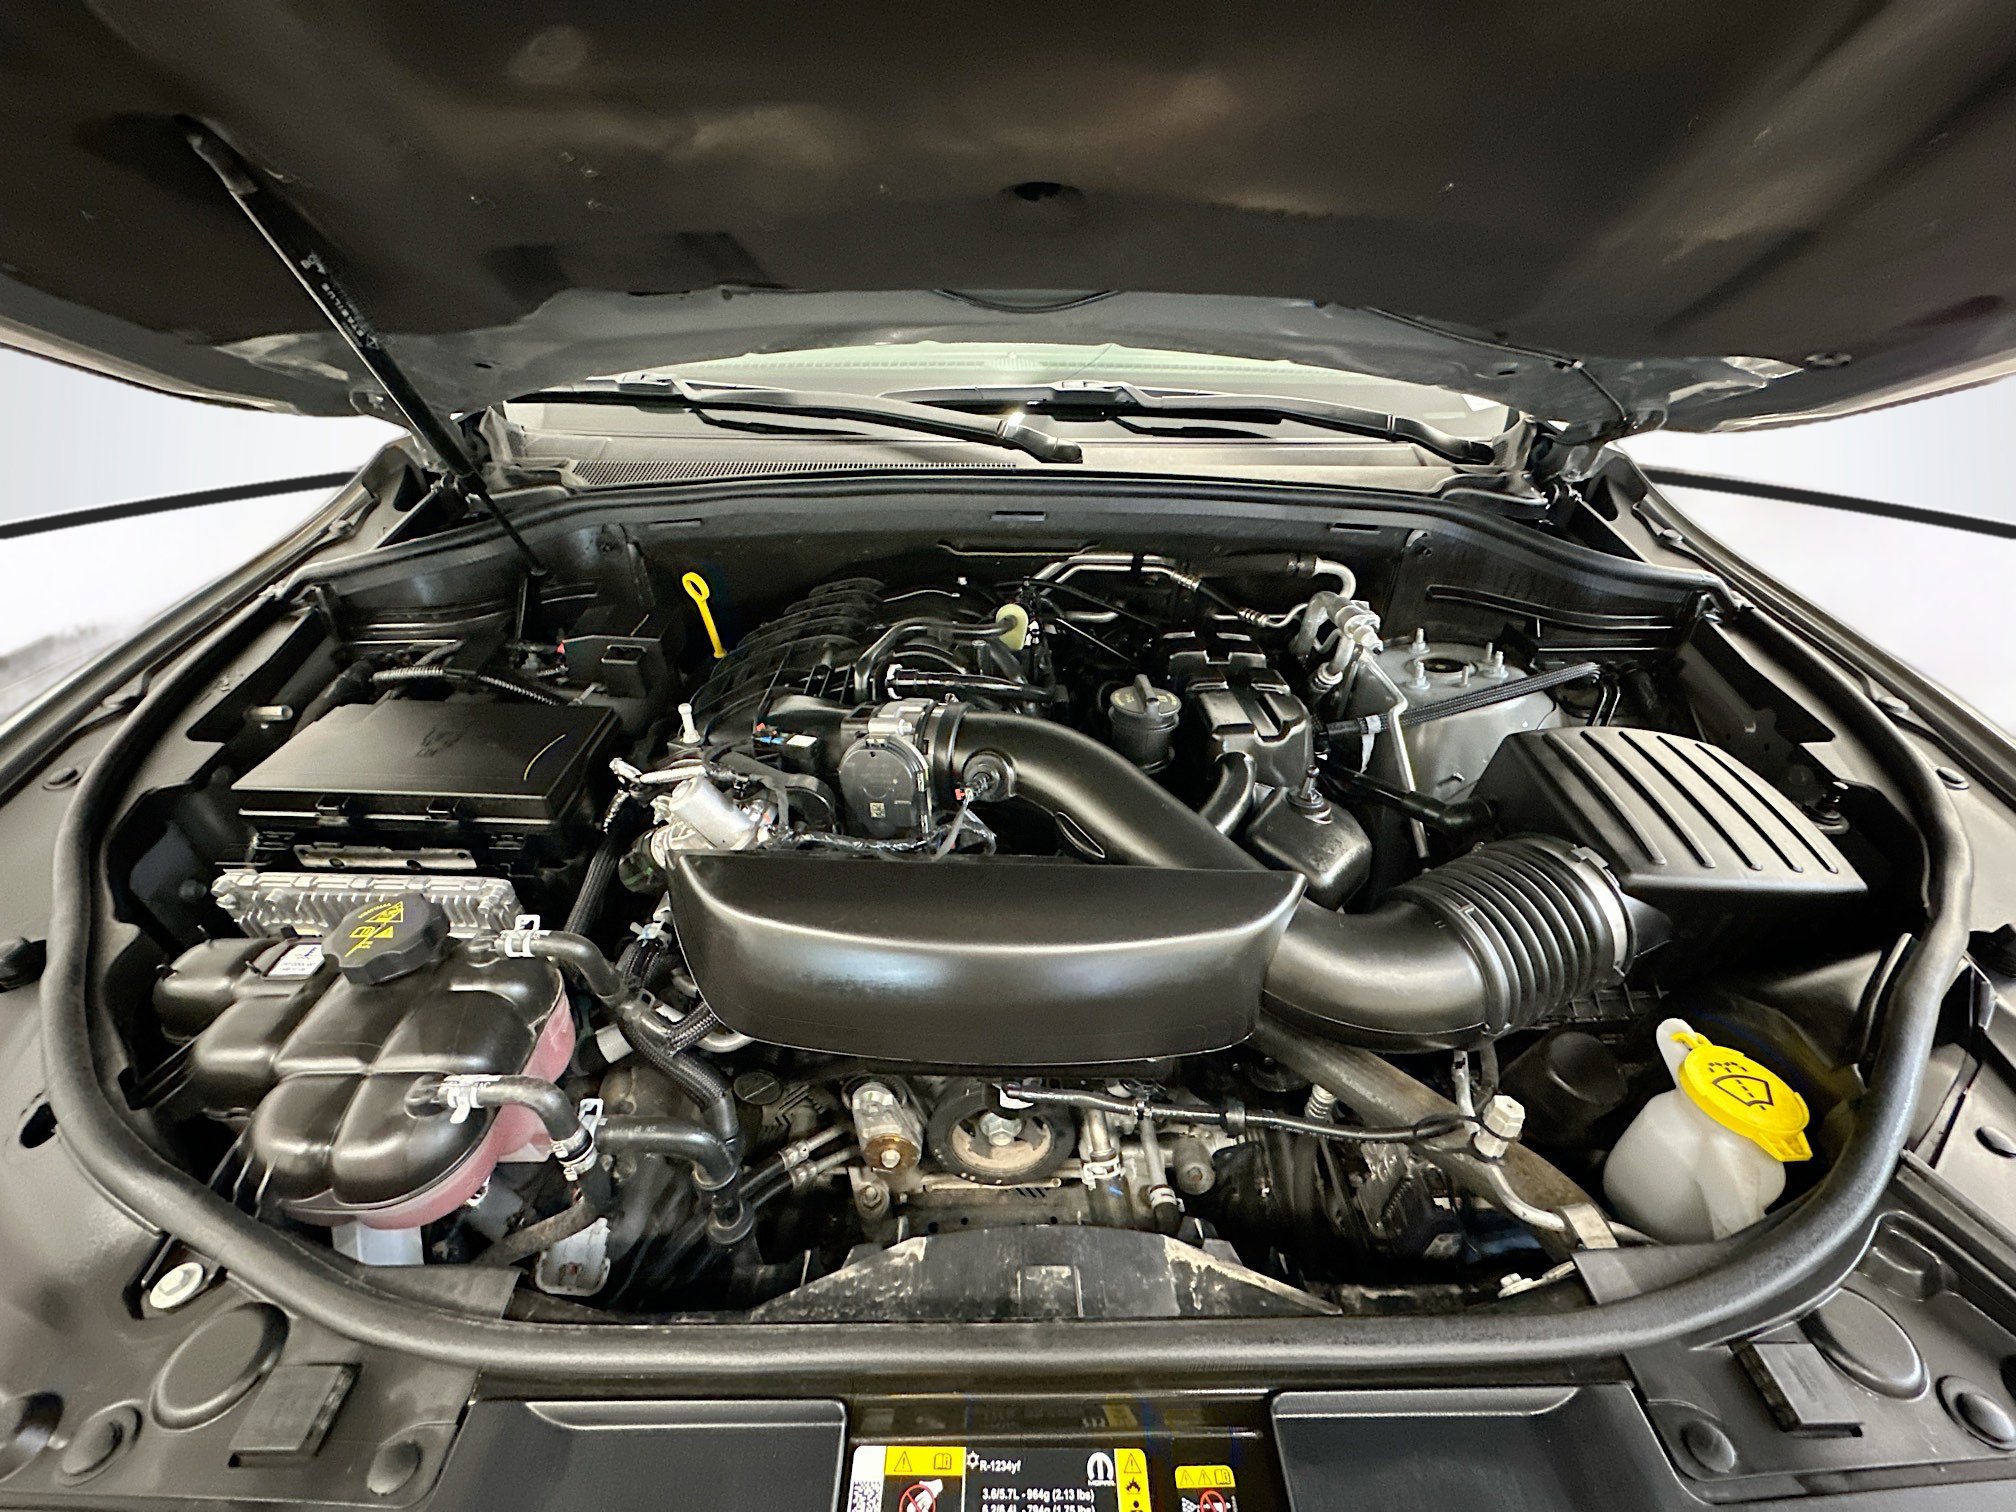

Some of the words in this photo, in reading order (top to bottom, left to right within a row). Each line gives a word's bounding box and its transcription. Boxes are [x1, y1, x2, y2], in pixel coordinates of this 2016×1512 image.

[321, 283, 364, 337] STABILUS
[979, 1459, 1021, 1475] R-1234yf
[982, 1487, 1020, 1500] 3.6/5.7L
[1052, 1488, 1075, 1503] (2.13
[1076, 1488, 1095, 1504] lbs)
